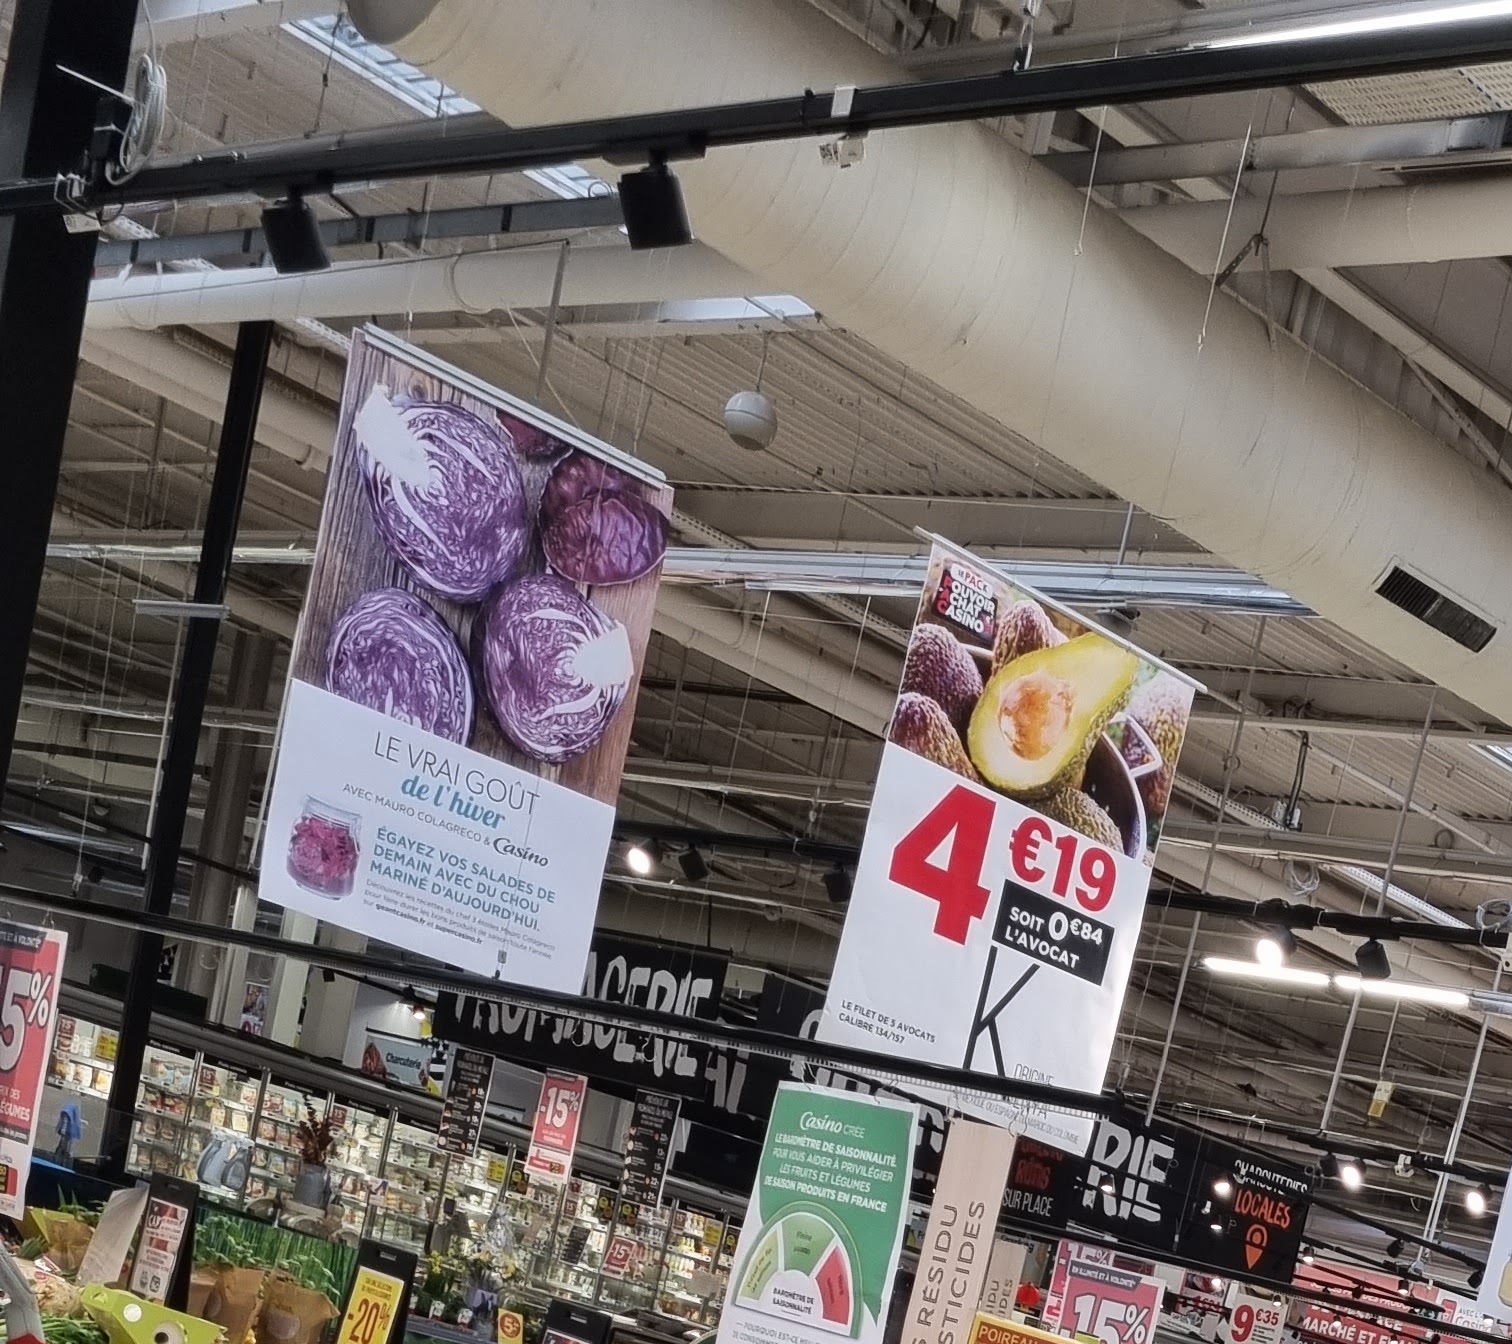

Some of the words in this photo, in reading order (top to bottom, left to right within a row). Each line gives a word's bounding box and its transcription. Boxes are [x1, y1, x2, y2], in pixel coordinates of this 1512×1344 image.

[944, 576, 995, 612] POUVOIR
[965, 572, 989, 592] PACK
[937, 600, 984, 633] CASINO
[374, 731, 402, 763] LE
[408, 744, 460, 786] VRAI
[466, 769, 541, 815] GOÛT
[400, 775, 430, 801] de
[434, 784, 505, 829] l'hiver
[342, 783, 372, 800] AVEC
[375, 793, 415, 817] MAURO
[417, 811, 482, 843] COLAGRECO
[493, 836, 549, 867] Casino
[373, 844, 432, 875] DEMAIN
[435, 867, 473, 890] AVEC
[476, 882, 497, 898] DU
[500, 891, 540, 914] CHOU
[377, 825, 435, 859] ÉGAYEZ
[439, 849, 468, 871] VOS
[471, 863, 534, 895] SALADES
[537, 886, 556, 904] DE
[889, 784, 996, 945] 4
[1009, 817, 1116, 912] €19
[370, 860, 430, 891] MARINÉ
[431, 882, 541, 932] D'AUJOURD'HUI.
[1010, 906, 1044, 932] SOIT
[1005, 925, 1079, 969] L'AVOCAT
[838, 1013, 874, 1034] CALIBRE
[854, 1003, 877, 1020] FILET
[896, 1020, 936, 1043] AVOCATS
[540, 1087, 580, 1128] -15%
[800, 1112, 842, 1133] Casino
[791, 1165, 817, 1181] FRUITS
[819, 1172, 830, 1183] ET
[831, 1173, 871, 1193] LÉGUMES
[807, 1154, 832, 1168] AIDER
[841, 1161, 894, 1182] PRIVILÉGIER
[797, 1182, 836, 1200] PRODUITS
[837, 1191, 850, 1203] EN
[850, 1194, 887, 1213] FRANCE
[1002, 1187, 1022, 1209] SUR
[1022, 1192, 1054, 1217] PLACE
[1235, 1189, 1290, 1228] LOCALES
[917, 1204, 958, 1326] RÉSIDU
[1231, 1305, 1254, 1342] 9
[1256, 1308, 1279, 1326] €35
[1302, 1316, 1356, 1341] MARCHÉ
[1358, 1330, 1374, 1344] ET
